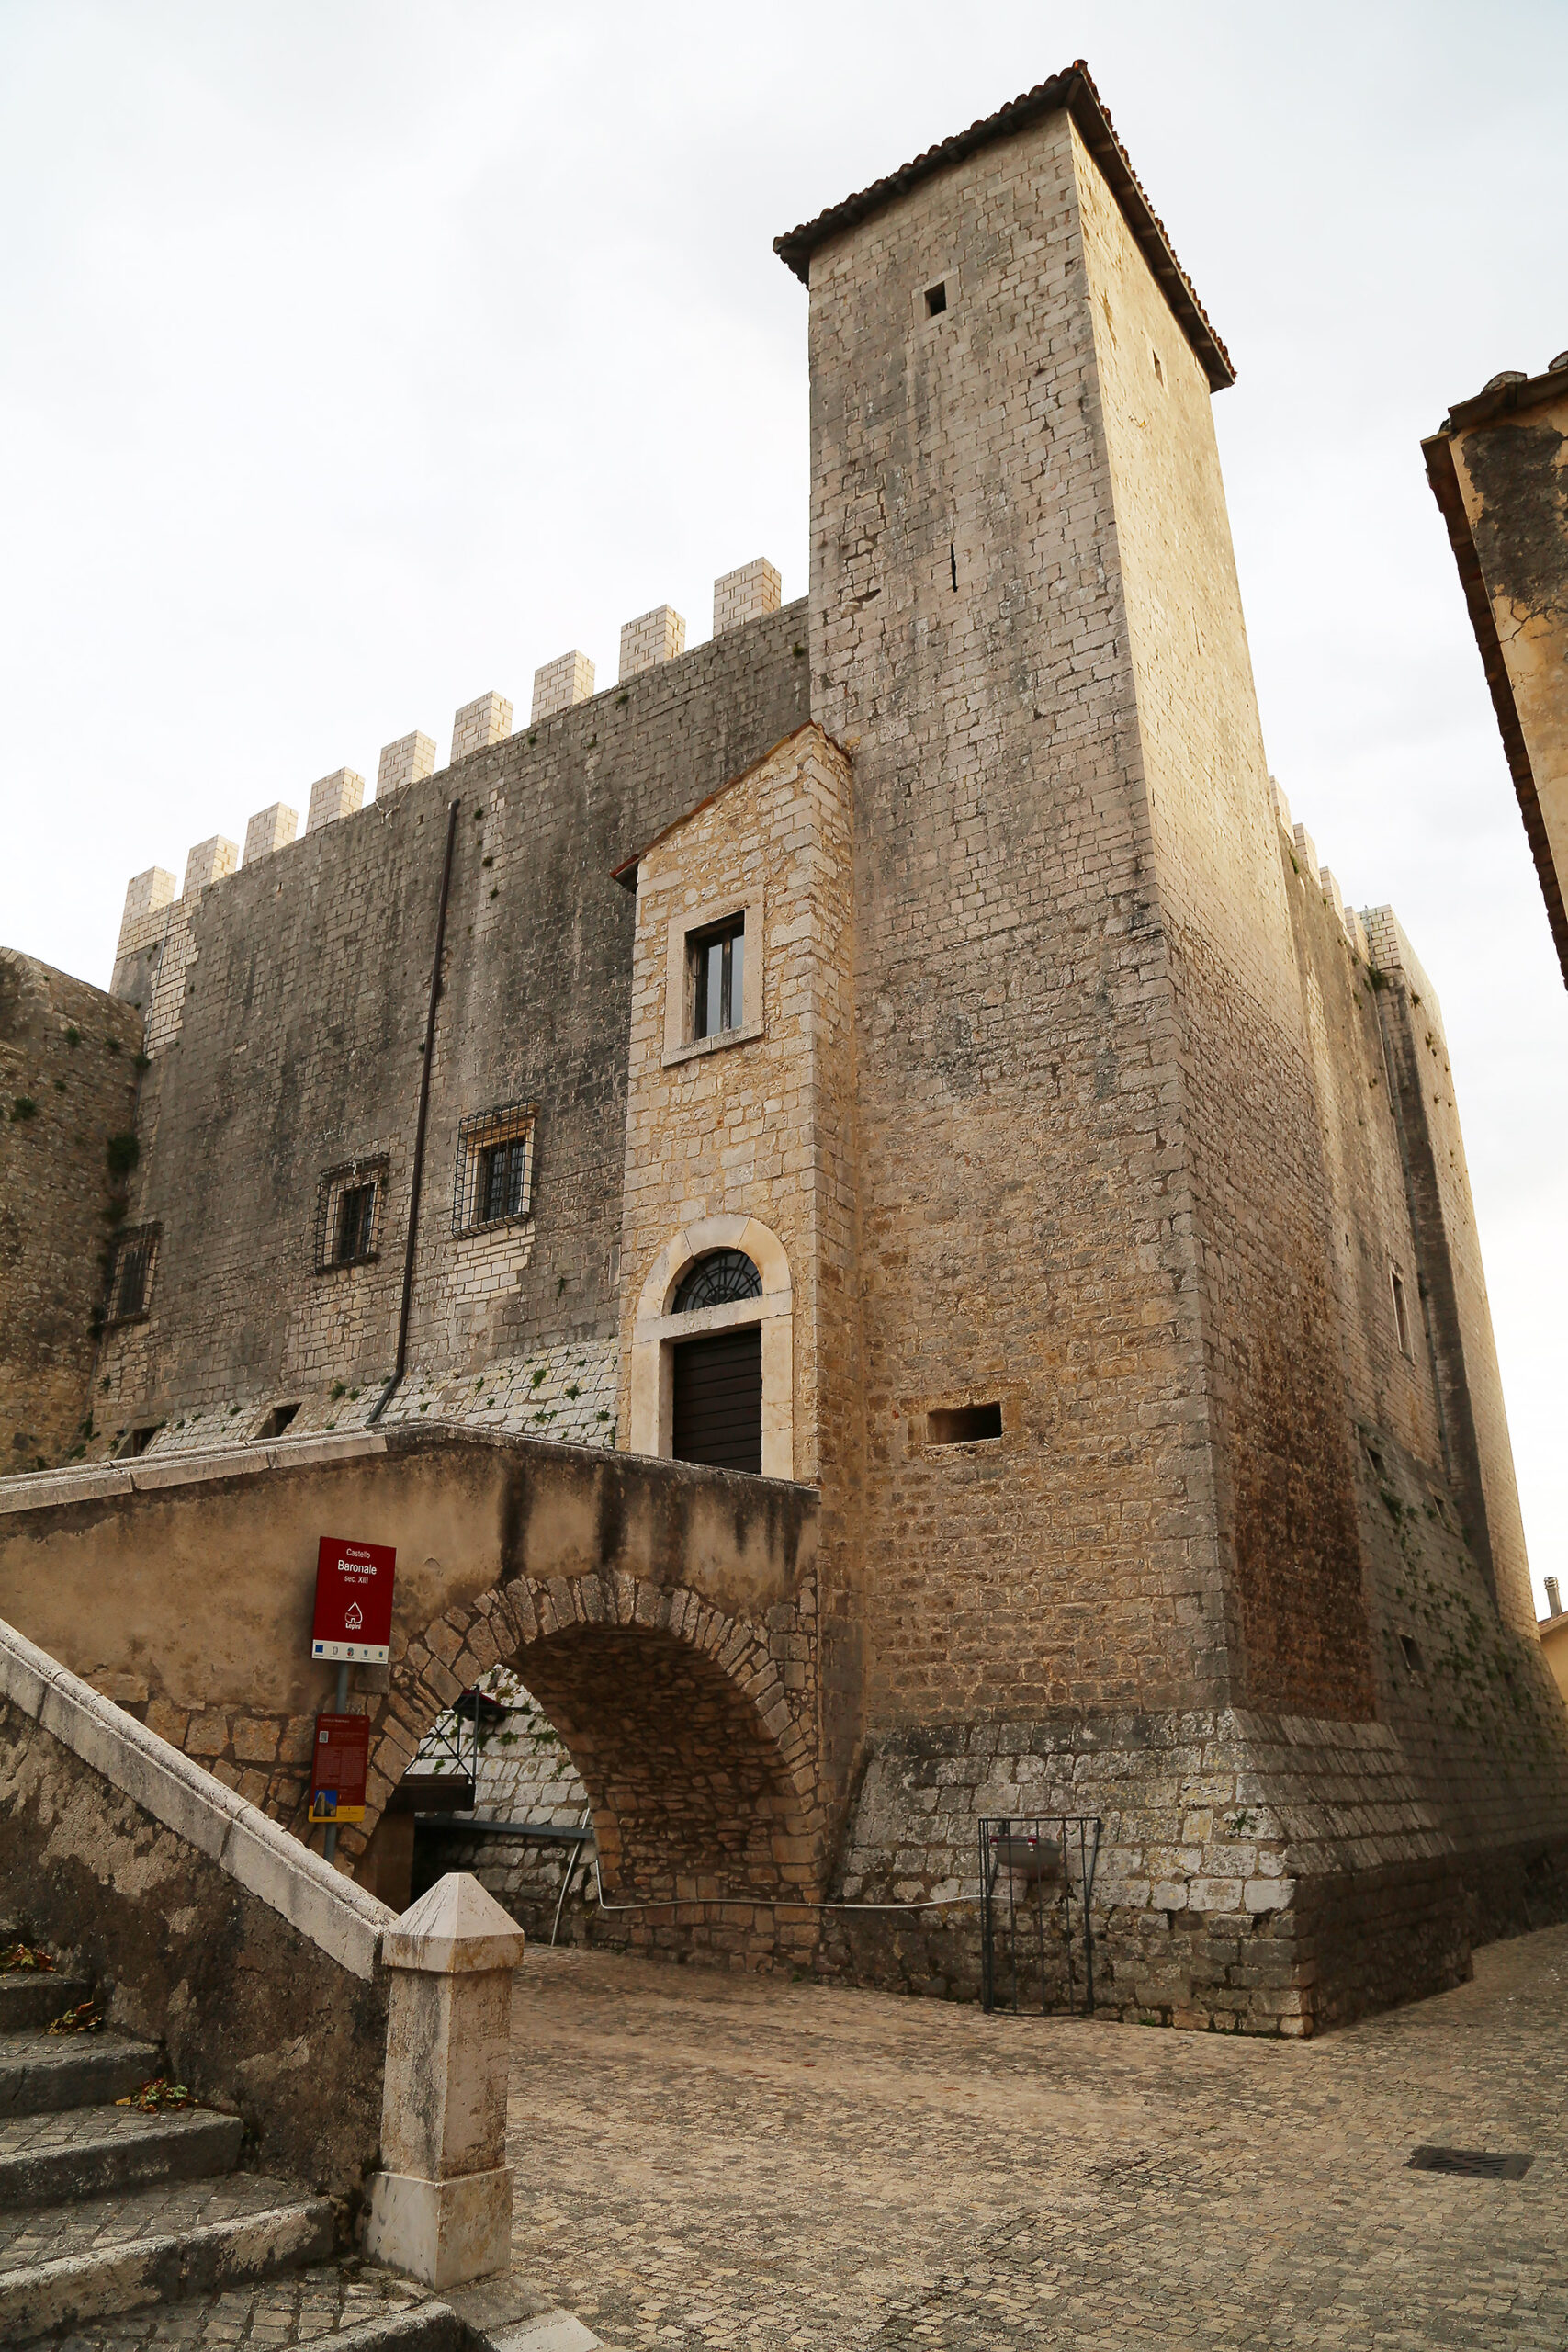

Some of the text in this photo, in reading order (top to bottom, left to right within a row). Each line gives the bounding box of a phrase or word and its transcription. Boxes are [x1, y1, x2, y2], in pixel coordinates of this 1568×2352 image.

[346, 1548, 370, 1559] Castello
[337, 1559, 377, 1575] Baronale
[357, 1576, 368, 1584] XIII
